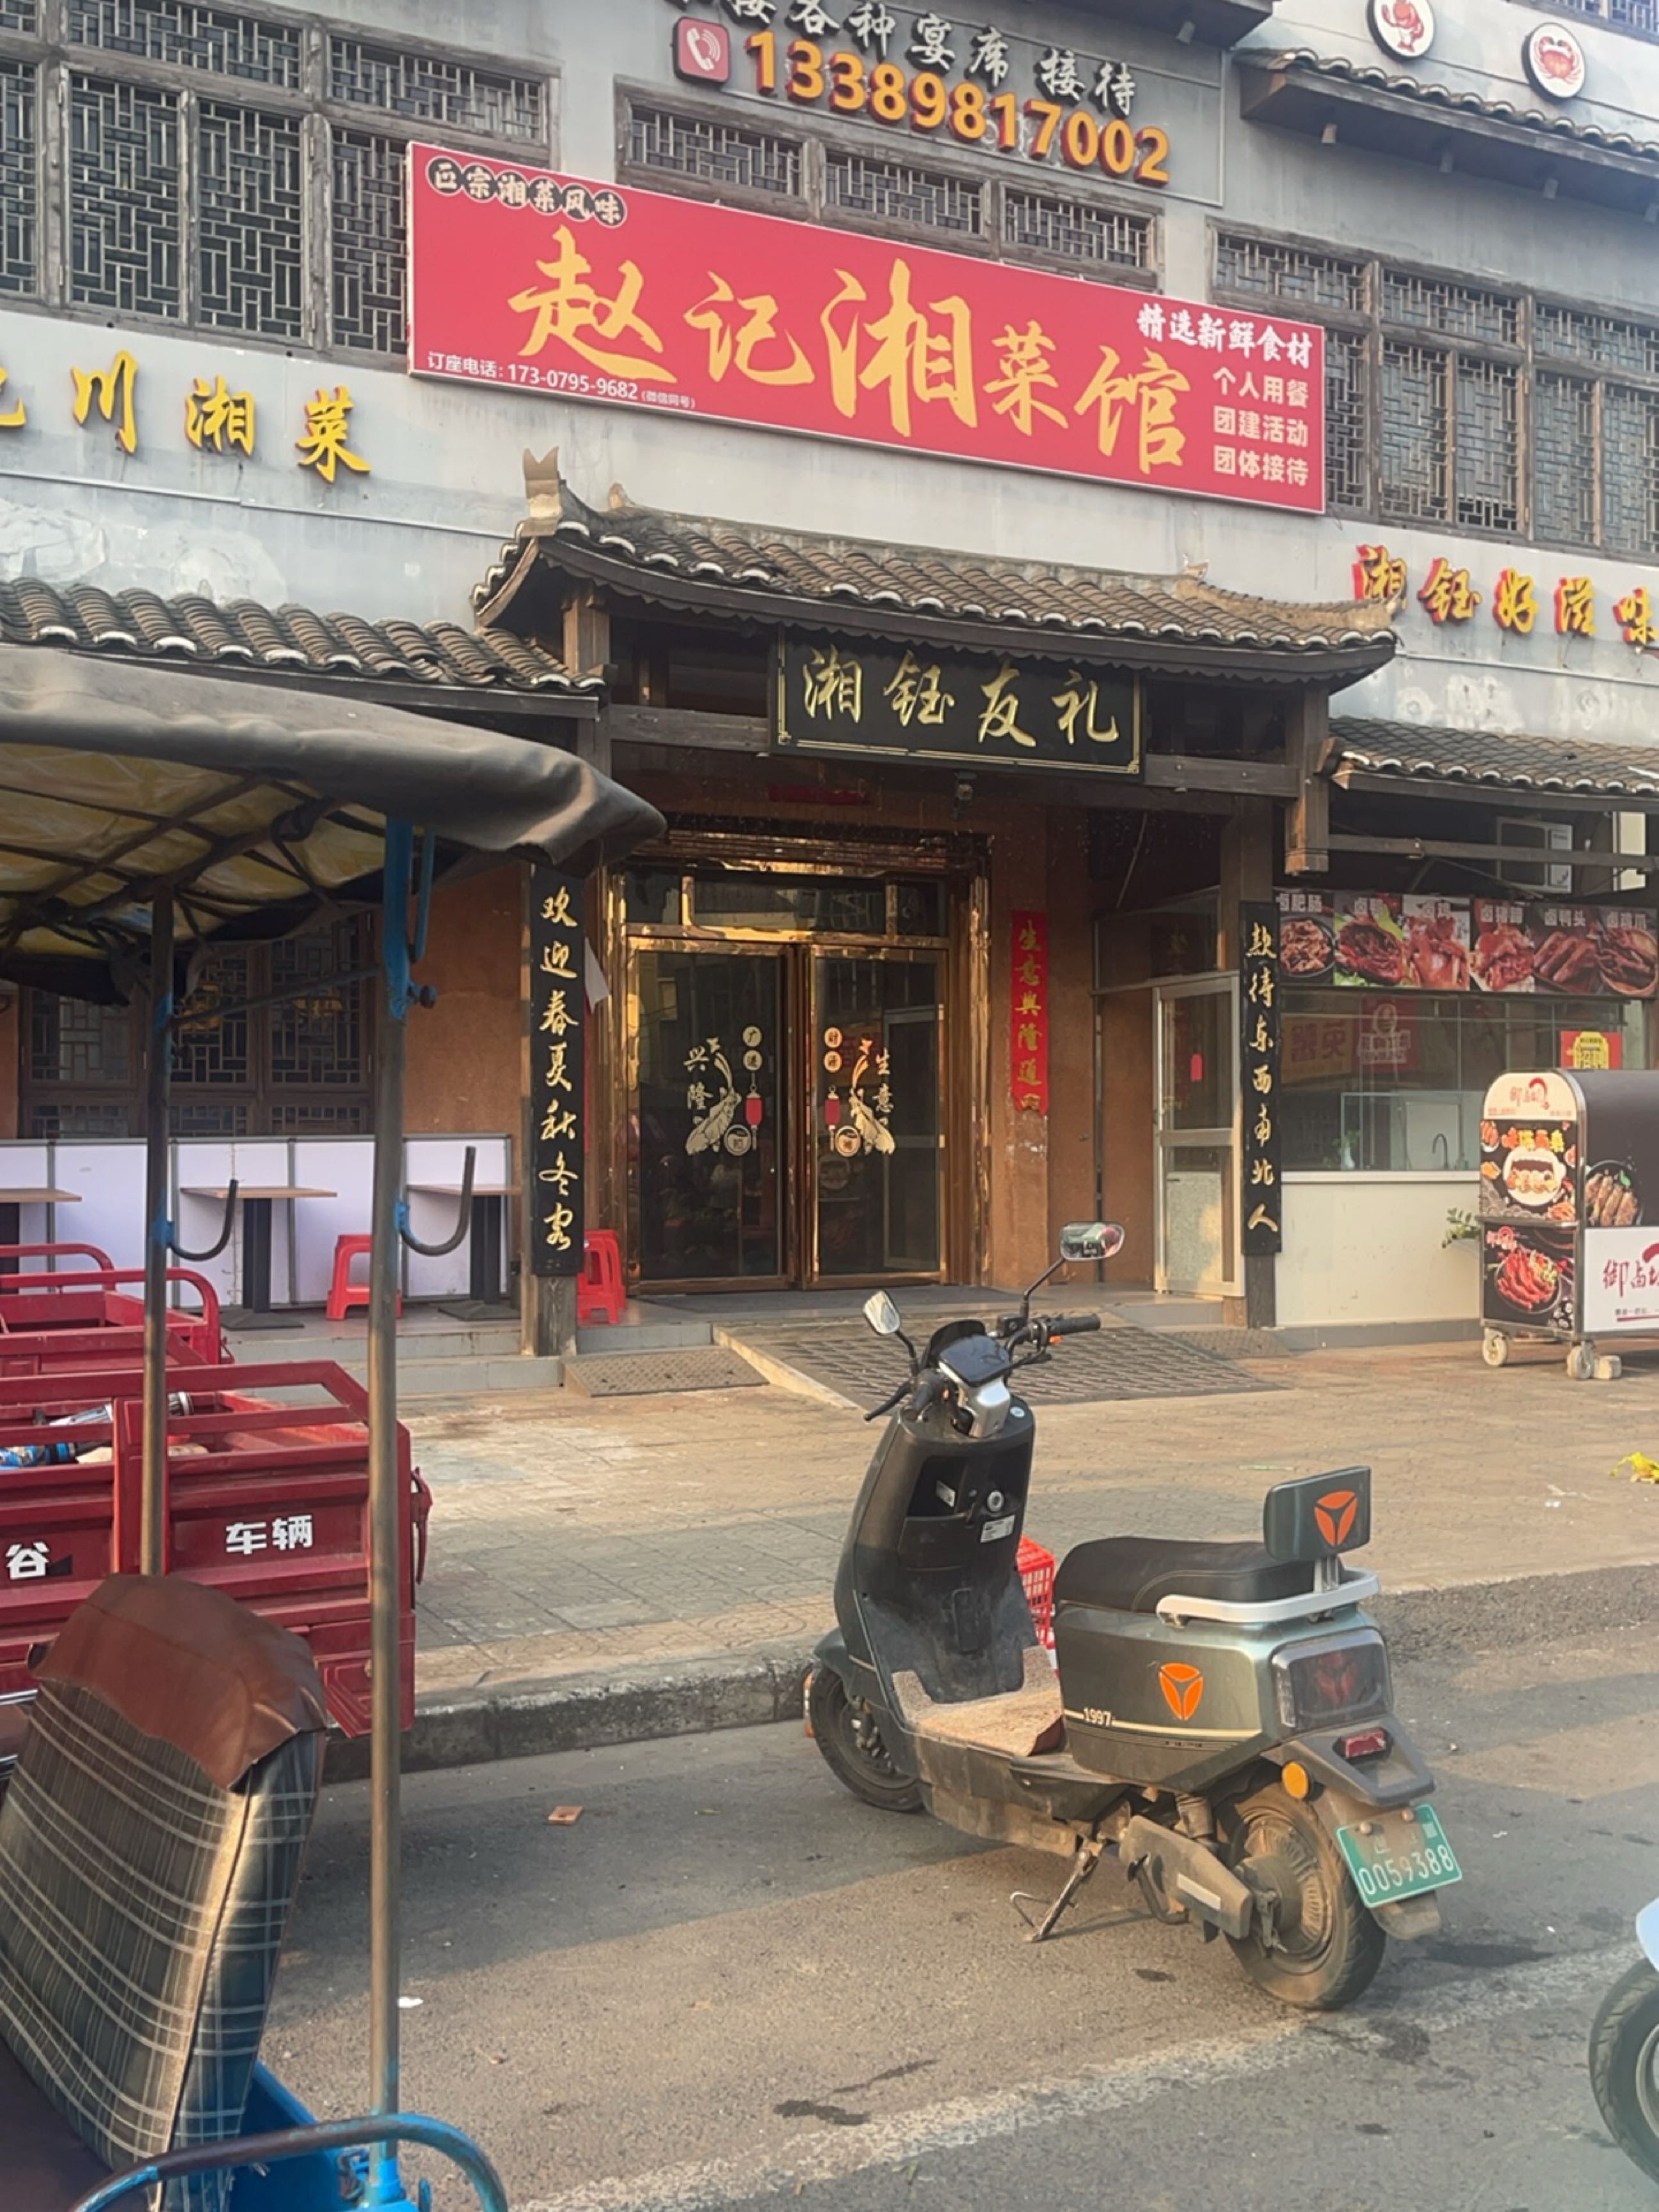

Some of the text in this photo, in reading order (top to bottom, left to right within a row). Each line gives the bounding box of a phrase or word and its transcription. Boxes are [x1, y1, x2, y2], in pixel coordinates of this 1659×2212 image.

[744, 29, 1169, 187] 13389817002
[507, 224, 1191, 475] 赵记湘菜馆
[1136, 303, 1312, 369] 精选新鲜食材
[1212, 366, 1309, 408] 个人用餐
[1213, 405, 1308, 447] 团建活动
[1213, 444, 1309, 486] 团体接待
[1352, 544, 1658, 646] 湘钰好滋味
[802, 643, 1120, 748] 湘钰友礼
[539, 885, 579, 1251] 欢迎春夏秋冬客
[6, 1514, 313, 1580] 谷 车辆
[1083, 1706, 1112, 1727] 1997
[1358, 1843, 1454, 1895] 0059388
